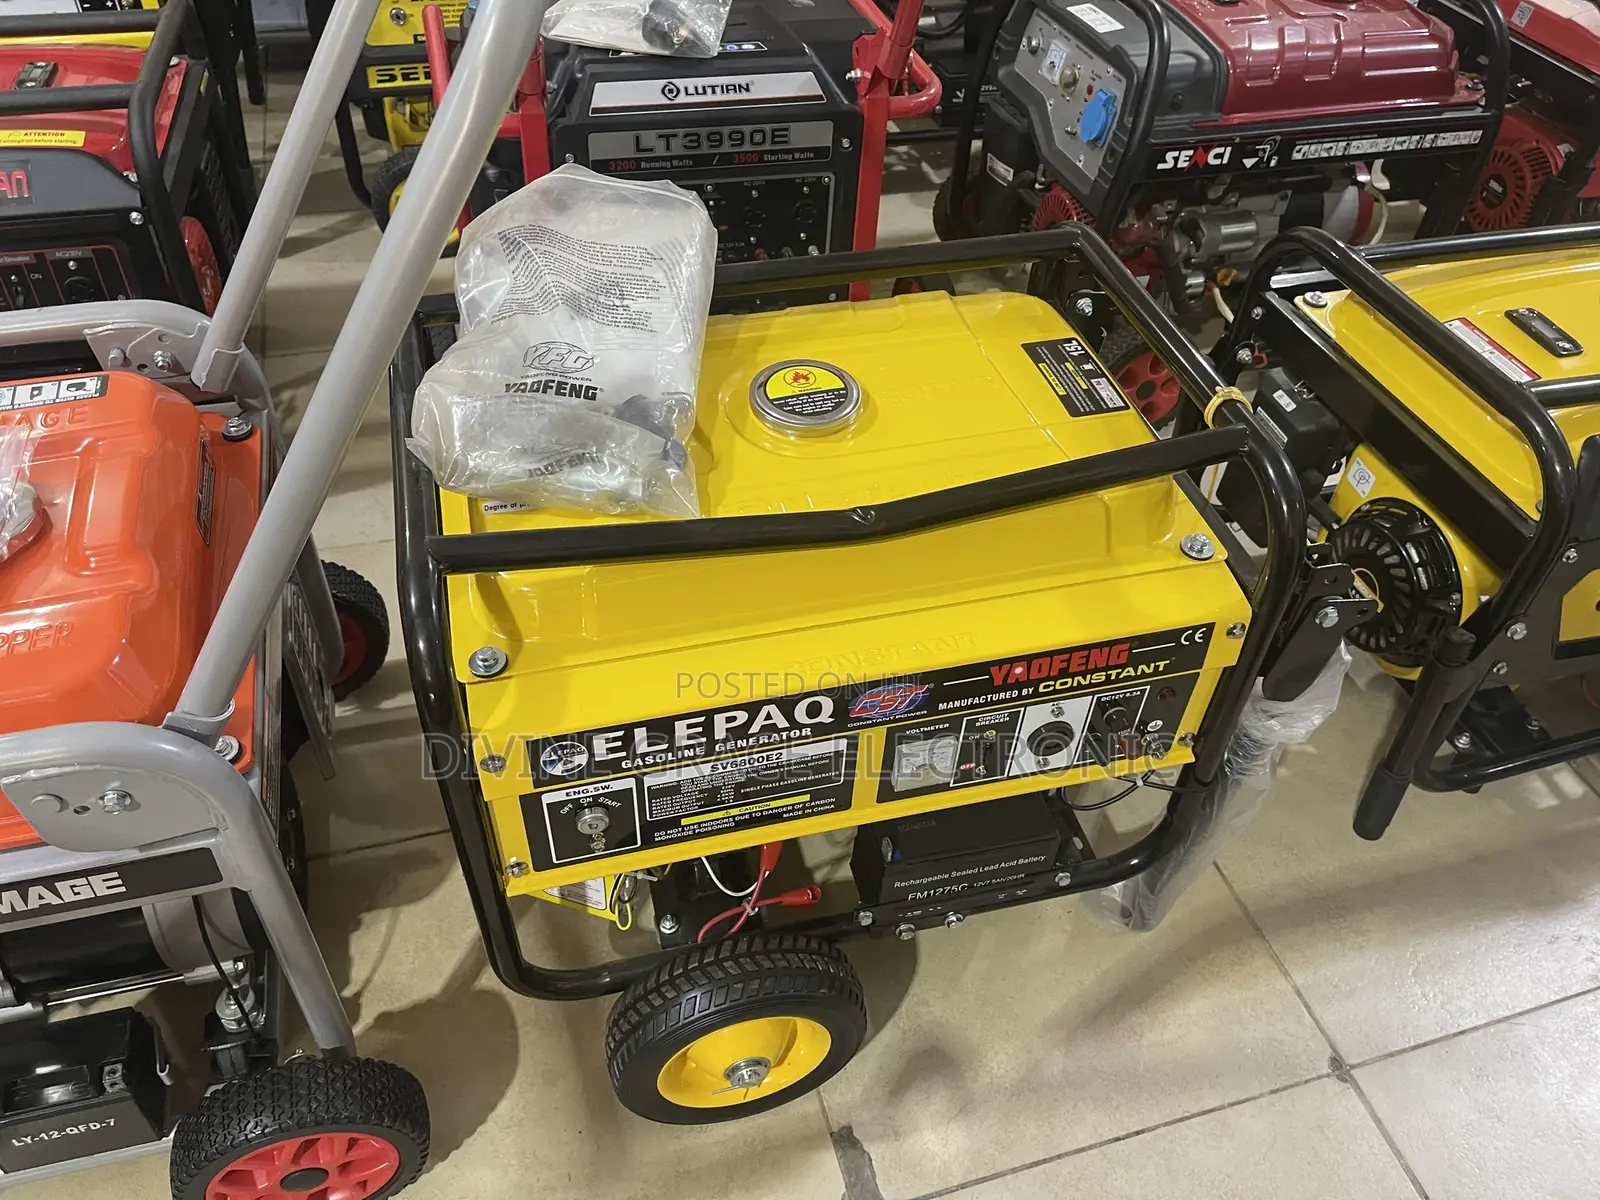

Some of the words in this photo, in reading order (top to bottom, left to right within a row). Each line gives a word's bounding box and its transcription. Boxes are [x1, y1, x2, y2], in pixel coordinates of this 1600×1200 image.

[684, 83, 750, 96] LUTIAN
[634, 125, 792, 154] LT3990E
[609, 160, 636, 171] 3200
[641, 160, 671, 170] Running
[672, 159, 693, 167] Watts
[733, 153, 759, 163] 3500
[764, 153, 793, 162] Starting
[794, 151, 814, 159] Watts
[1156, 145, 1232, 172] SENCI
[559, 373, 592, 382] POWER
[504, 379, 599, 402] YAOFENG
[1181, 628, 1206, 645] CE
[989, 642, 1131, 687] YAOFENG
[1038, 660, 1170, 693] CONSTANT
[938, 691, 1020, 711] MANUFACTURED
[1021, 686, 1034, 696] BY
[847, 715, 895, 728] CONSTANT
[895, 709, 928, 720] POWER
[975, 716, 1010, 727] BREAKER
[978, 712, 1010, 722] CIRCUIT
[592, 695, 835, 762] ELEPAQ
[905, 723, 950, 735] VOLTMETER
[621, 747, 705, 770] GASOLINE
[714, 727, 813, 752] GENERATOR
[710, 752, 784, 773] SV6800E2
[741, 785, 761, 793] SINGLE
[761, 781, 779, 789] PHASE
[780, 776, 807, 786] GASOLINE
[807, 771, 840, 780] GENERATOR
[672, 790, 700, 799] VOLTAGE
[672, 799, 696, 807] OUTPUT
[560, 803, 574, 815] OFF
[579, 796, 593, 804] ON
[597, 796, 622, 809] START
[652, 810, 674, 818] POWER
[681, 801, 705, 809] OUTPUT
[700, 817, 734, 827] INDOORS
[762, 806, 793, 816] DANGER
[805, 797, 836, 807] CARBON
[739, 802, 771, 813] CAUTION
[783, 810, 804, 818] MADE
[813, 804, 835, 812] CHINA
[654, 830, 694, 842] MONOXIDE
[695, 822, 735, 834] POISONING
[894, 872, 950, 889] Rechargeable
[950, 867, 979, 878] Sealed
[979, 863, 1000, 873] Lead
[999, 859, 1017, 868] Acid
[1018, 854, 1046, 866] Battery
[11, 1118, 116, 1147] LY-12-QFD-7
